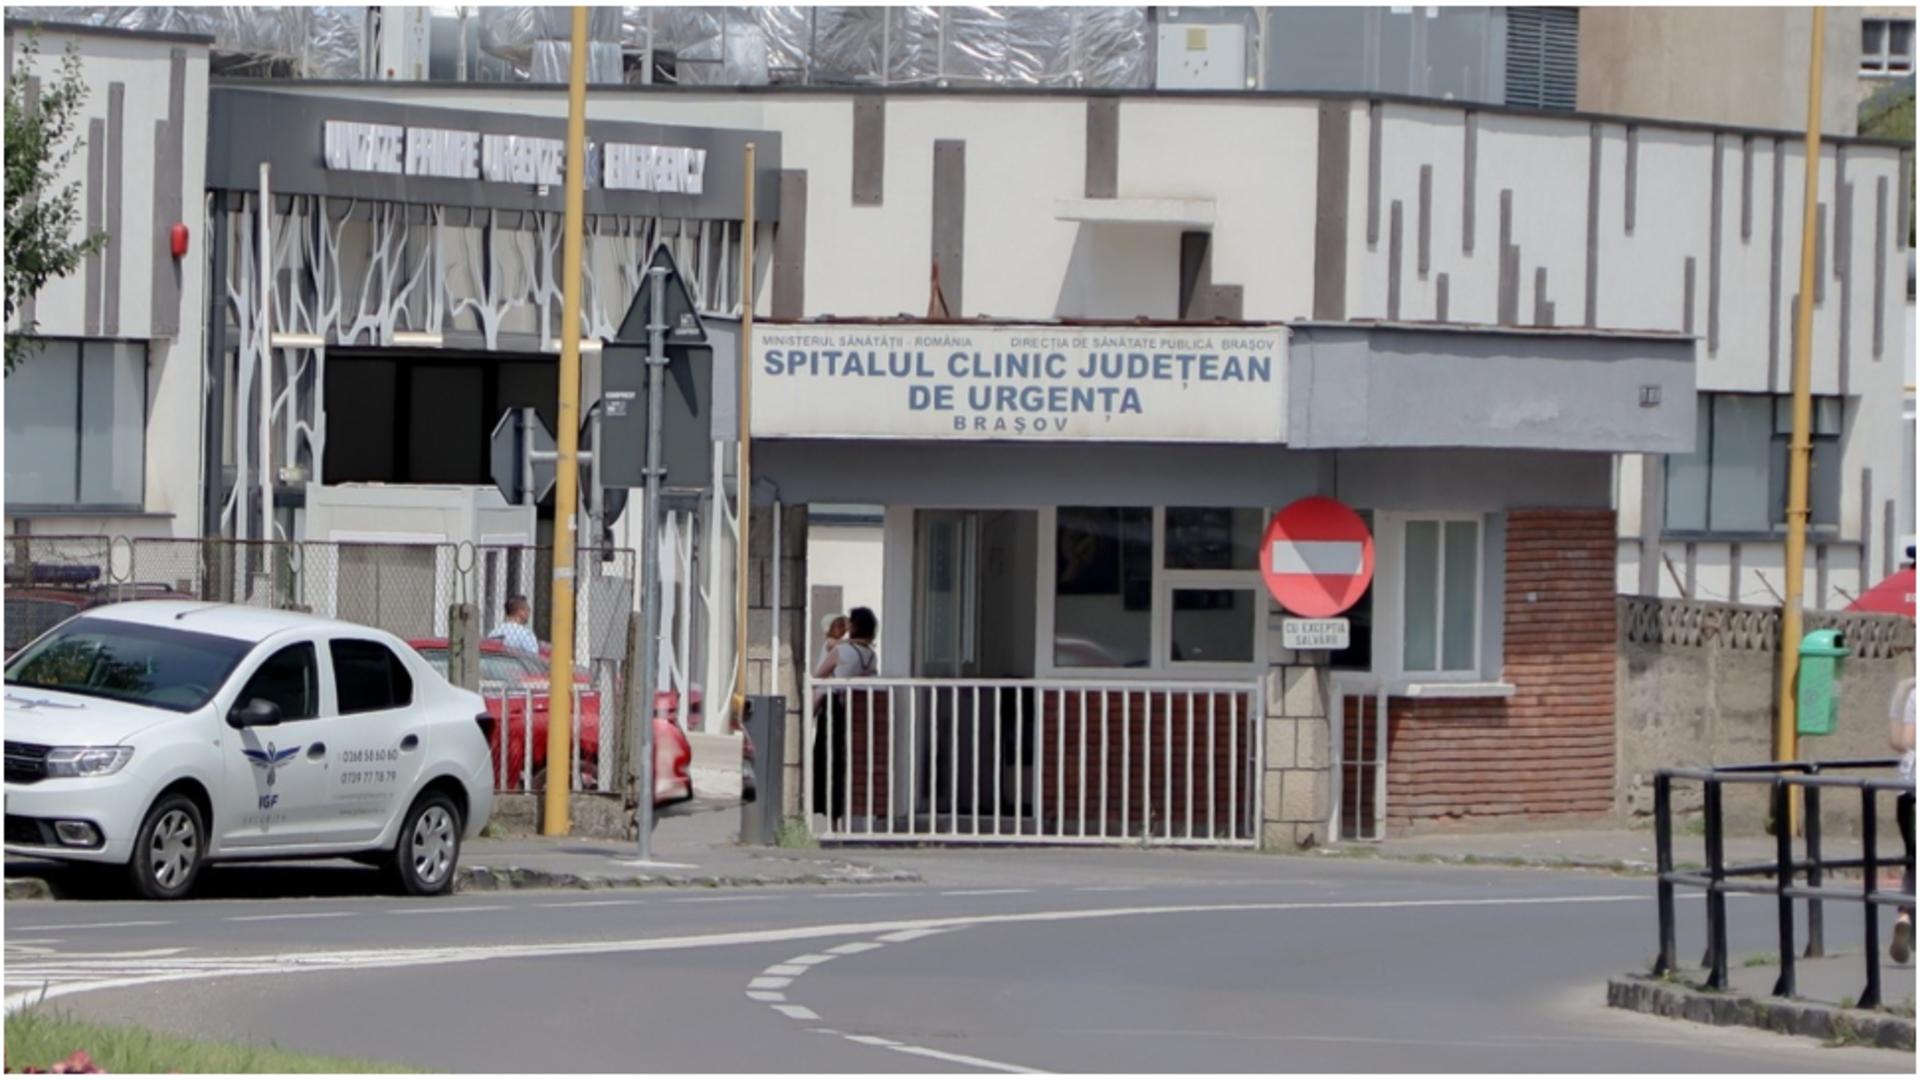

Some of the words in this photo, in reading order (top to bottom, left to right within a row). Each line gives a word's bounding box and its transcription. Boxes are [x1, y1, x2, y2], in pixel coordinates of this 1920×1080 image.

[762, 335, 835, 347] MINISTERUL
[914, 335, 973, 347] ROMÂNIA
[1071, 337, 1087, 348] DE
[763, 350, 935, 377] SPITALUL
[947, 352, 1067, 378] CLINIC
[1077, 353, 1272, 390] JUDEȚEAN
[908, 385, 955, 410] DE
[968, 385, 1143, 423] URGENȚA
[258, 794, 279, 809] IGF
